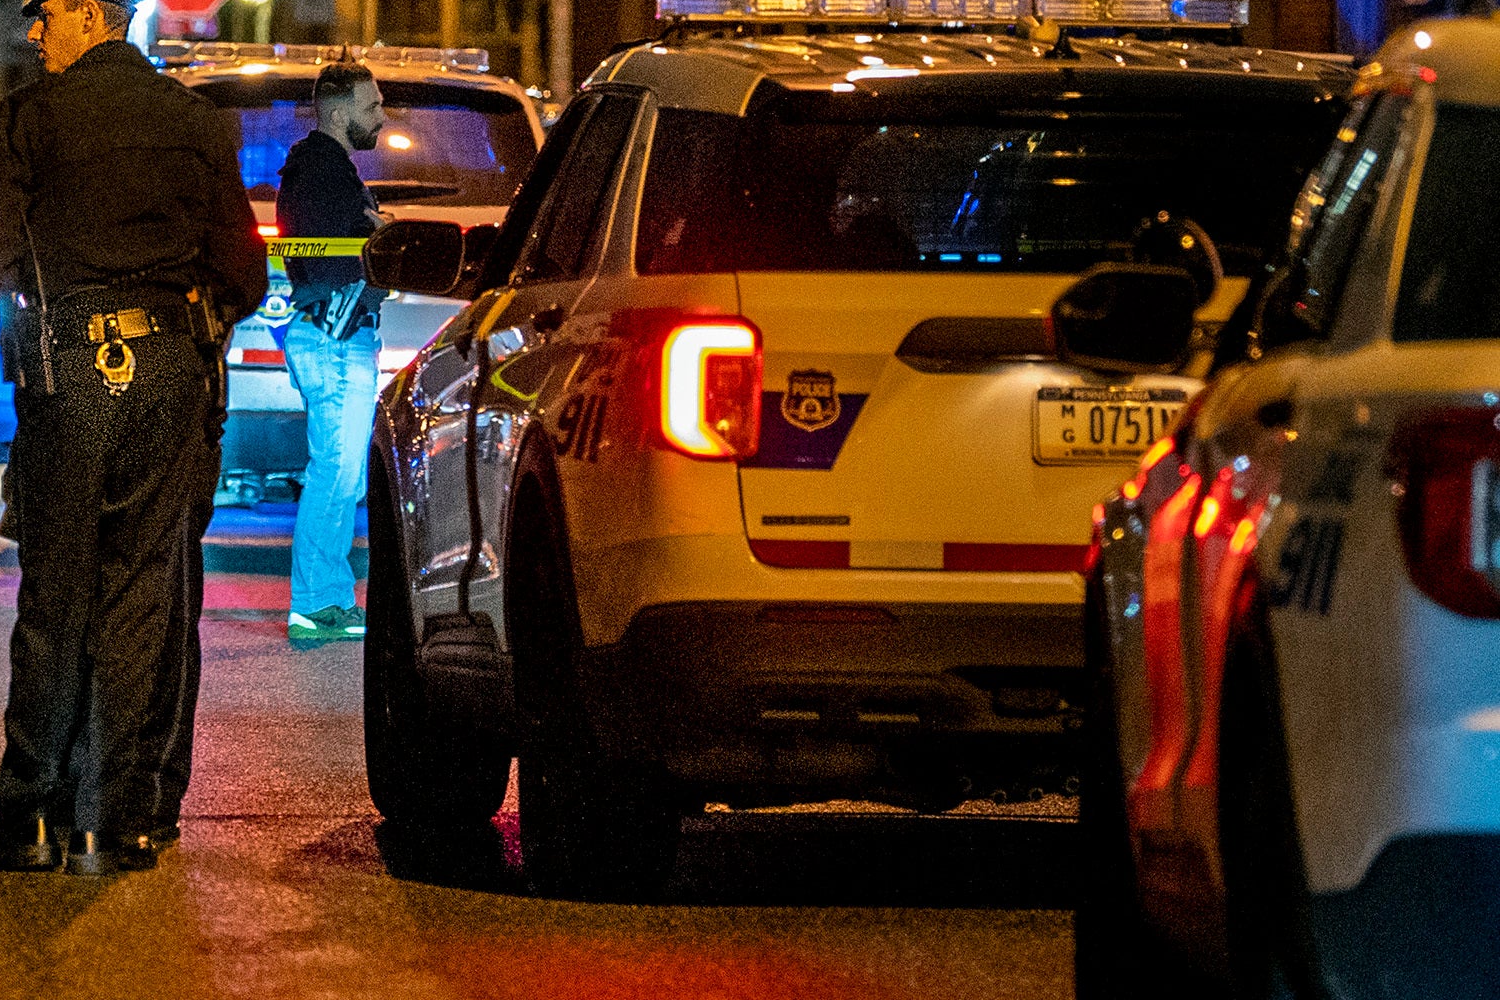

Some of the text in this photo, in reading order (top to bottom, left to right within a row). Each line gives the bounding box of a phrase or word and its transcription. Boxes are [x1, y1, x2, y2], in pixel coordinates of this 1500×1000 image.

[269, 243, 328, 256] POLICE LINE
[792, 383, 831, 397] POLICE
[1061, 405, 1075, 417] M
[556, 394, 608, 463] 911
[1062, 428, 1075, 443] G
[1267, 517, 1344, 615] 911
